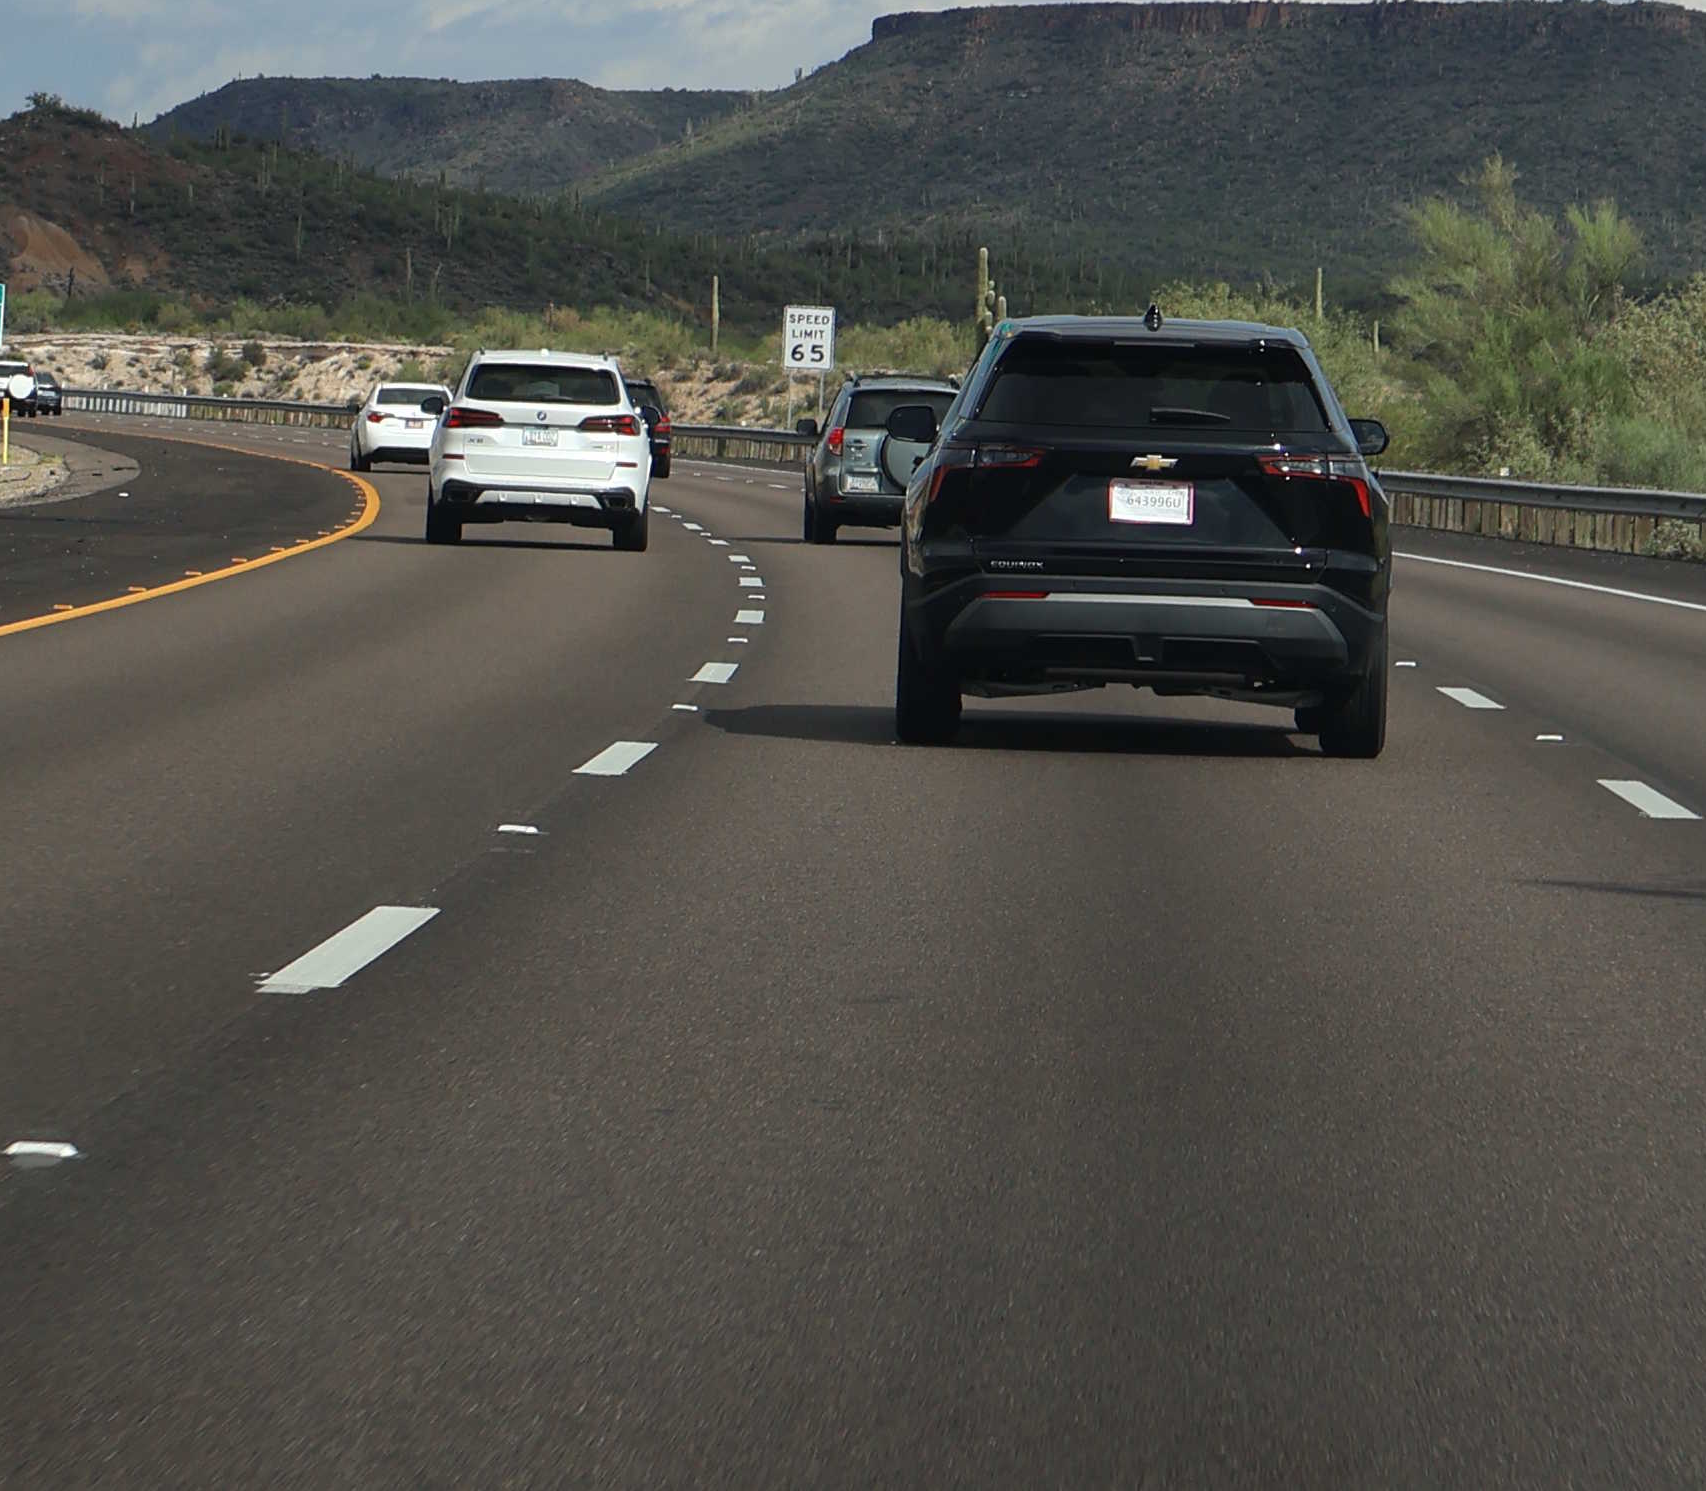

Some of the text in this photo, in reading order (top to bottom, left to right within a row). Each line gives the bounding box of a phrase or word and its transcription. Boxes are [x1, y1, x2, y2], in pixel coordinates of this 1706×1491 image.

[789, 314, 830, 325] SPEED
[792, 329, 825, 339] LIMIT
[791, 344, 824, 362] 65
